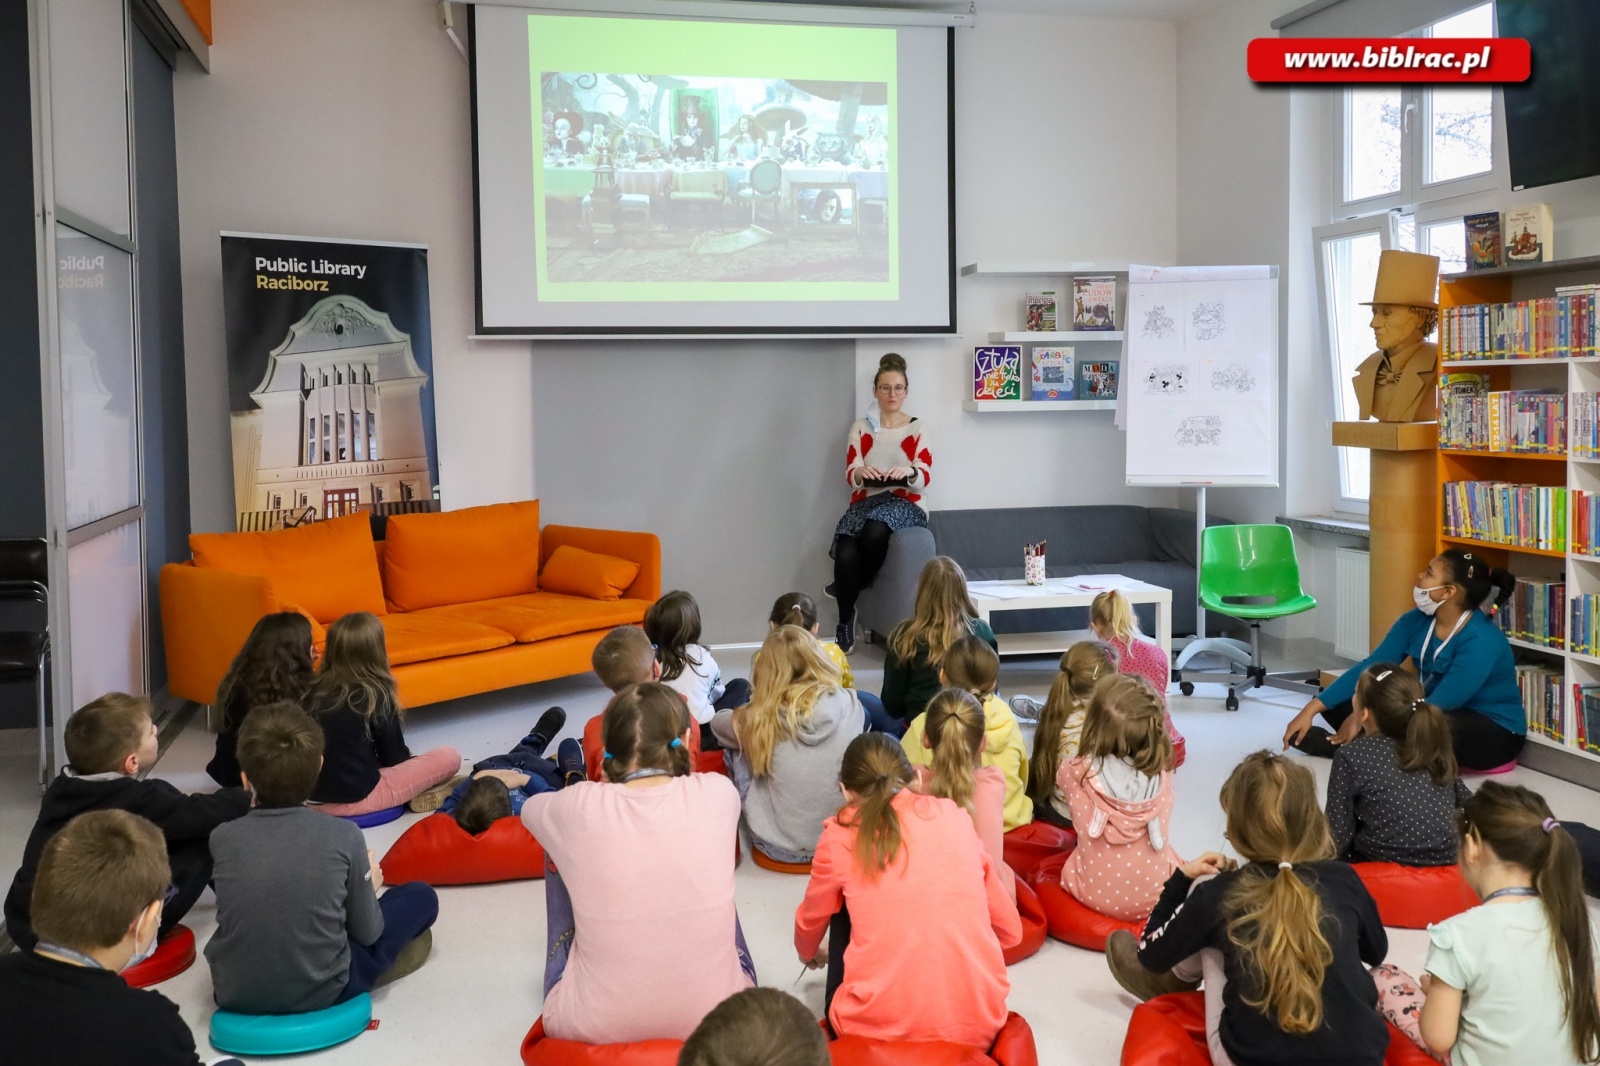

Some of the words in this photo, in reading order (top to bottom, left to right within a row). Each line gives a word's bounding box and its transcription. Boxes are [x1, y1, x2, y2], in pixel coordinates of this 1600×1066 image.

[255, 256, 308, 273] Public
[311, 259, 367, 279] Library
[256, 275, 330, 292] Raciborz
[1492, 397, 1500, 417] LAT
